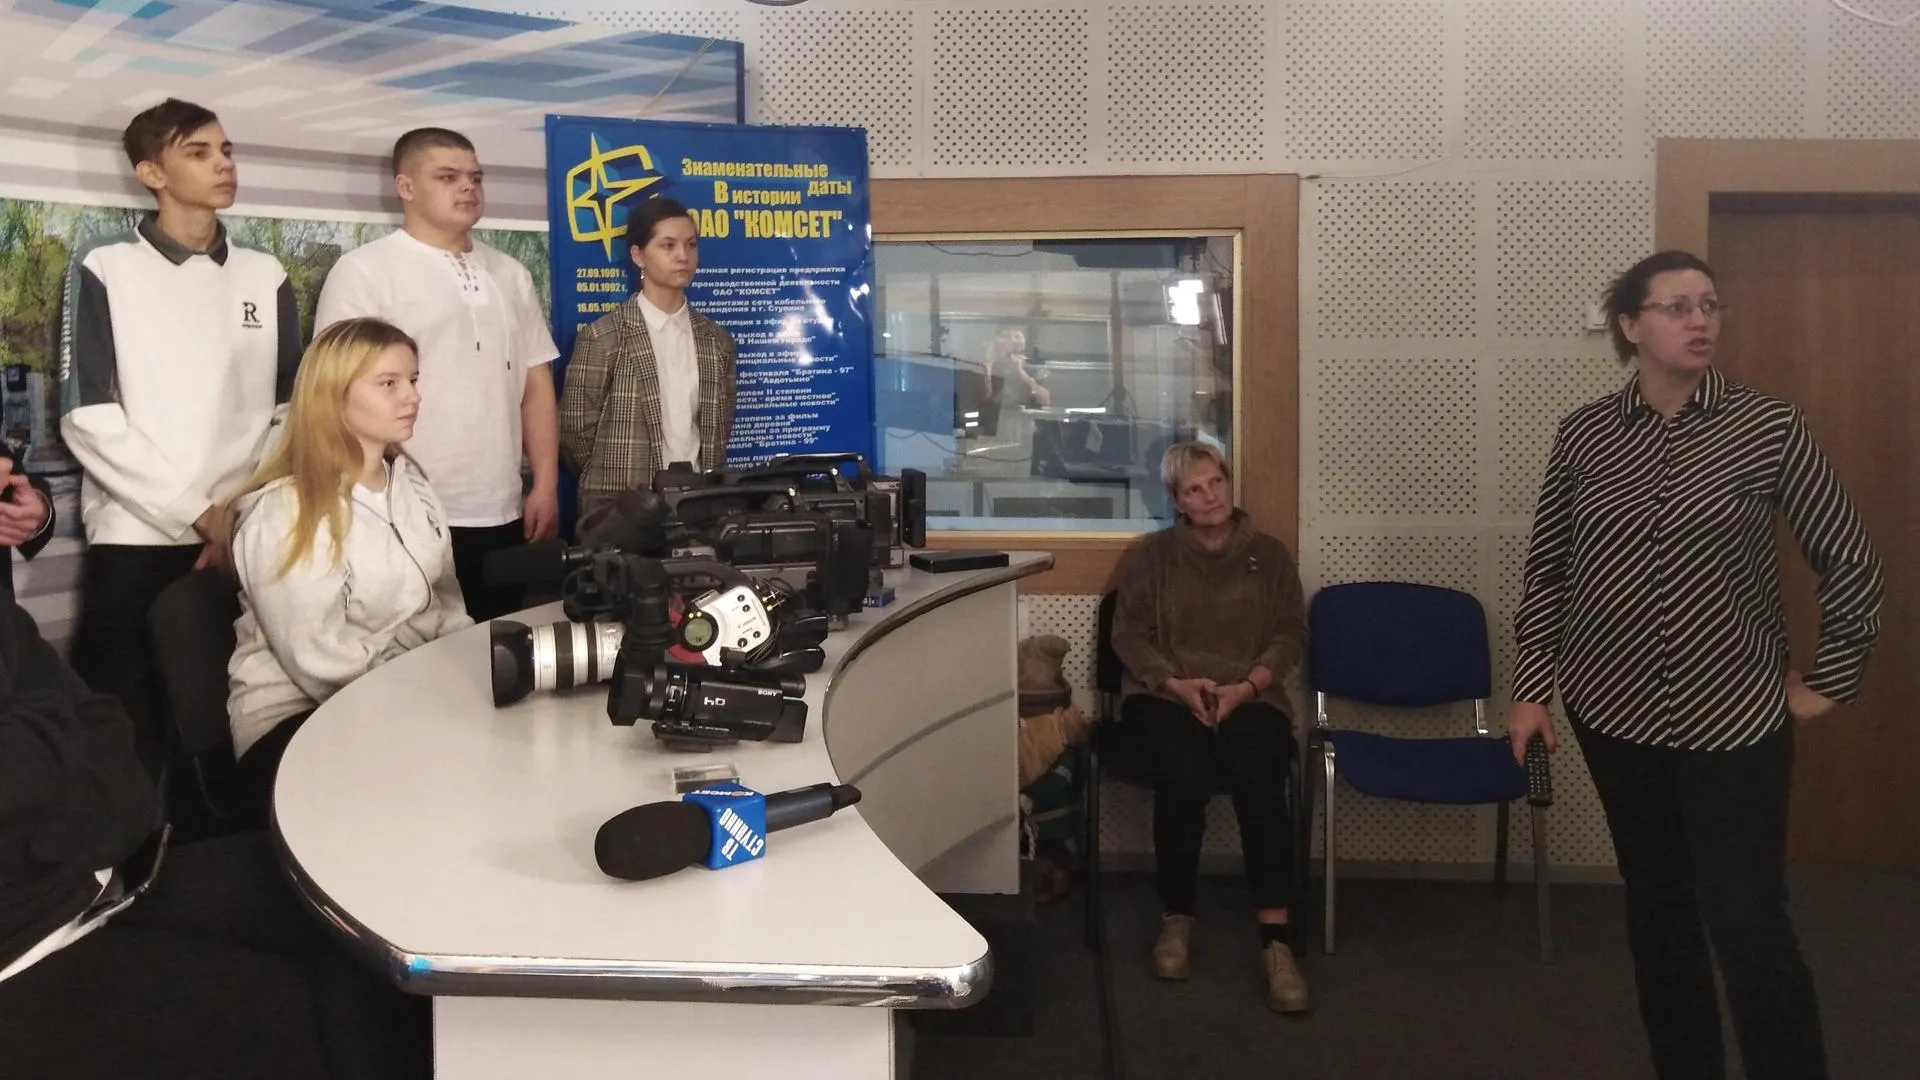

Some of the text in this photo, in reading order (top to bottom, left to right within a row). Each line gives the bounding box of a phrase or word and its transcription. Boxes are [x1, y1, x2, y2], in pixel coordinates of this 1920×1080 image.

[682, 158, 829, 178] Знаменательные
[714, 180, 801, 206] В истории
[807, 180, 852, 197] даты
[734, 210, 842, 238] "КОМСЕТ"
[730, 267, 787, 275] регистрация
[691, 280, 776, 288] производственной
[712, 288, 781, 296] ОАО "КОМСЕТ"
[242, 301, 259, 322] R
[740, 370, 789, 379] фестиваля
[787, 413, 819, 421] фильм
[782, 425, 831, 433] программу
[757, 689, 777, 697] SONY
[719, 808, 764, 857] СТУПИНО
[721, 837, 739, 861] ТВ
